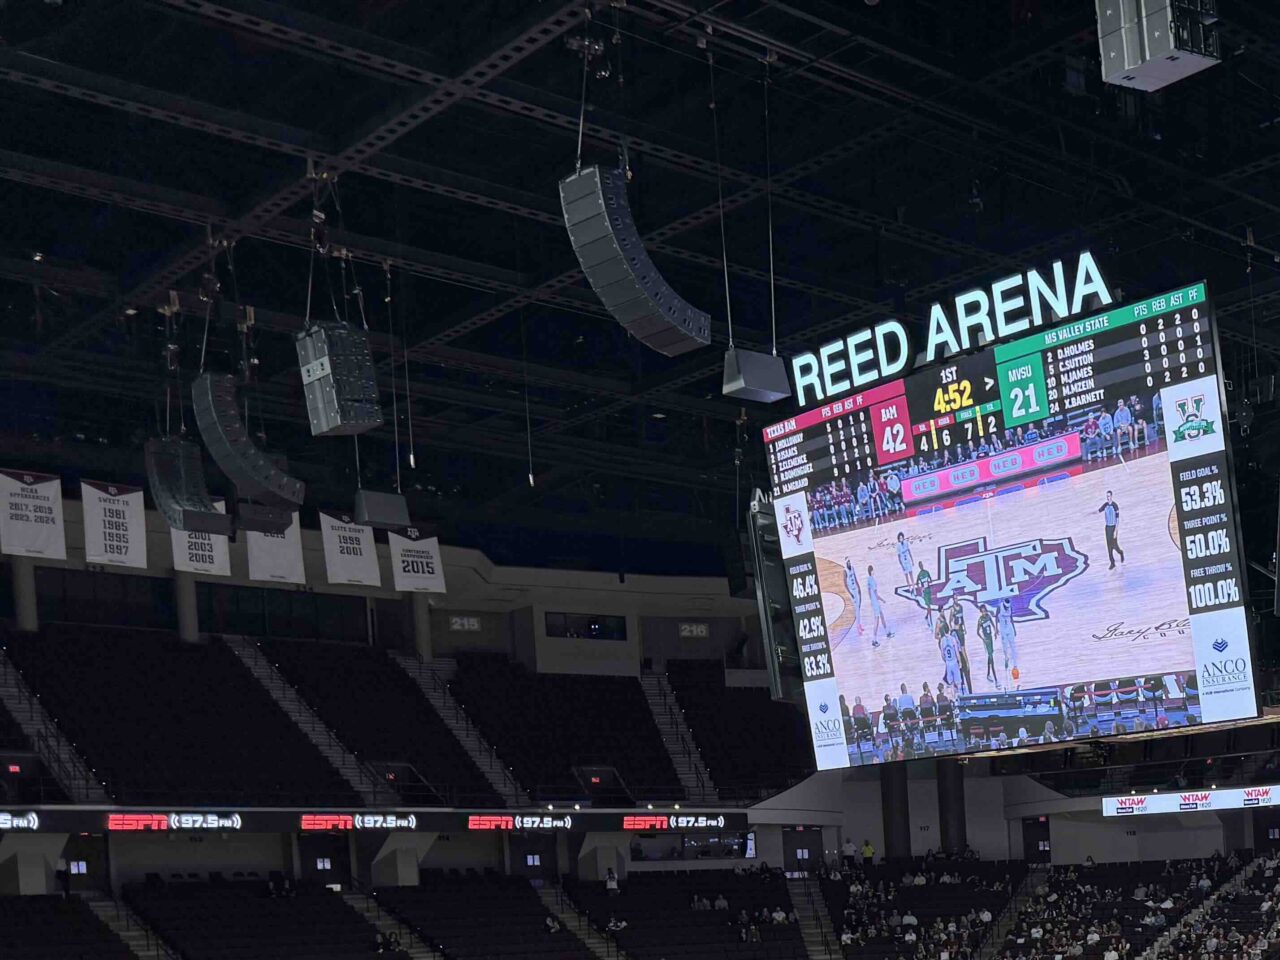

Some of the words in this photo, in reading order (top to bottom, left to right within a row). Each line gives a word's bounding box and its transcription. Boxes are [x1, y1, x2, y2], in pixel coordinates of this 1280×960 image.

[1045, 333, 1057, 346] MS
[1058, 324, 1084, 341] VALLEY
[1085, 316, 1110, 332] STATE
[1134, 305, 1148, 318] PTS
[1152, 299, 1166, 313] REB
[1170, 293, 1183, 307] AST
[1188, 288, 1198, 301] PF
[791, 318, 909, 407] REED
[925, 249, 1113, 362] ARENA
[1047, 352, 1053, 363] 2
[1057, 340, 1095, 360] D.HOLMES
[1140, 324, 1147, 335] 0
[1157, 319, 1164, 330] 2
[1174, 313, 1181, 325] 2
[1191, 308, 1198, 319] 0
[1048, 364, 1055, 375] 5
[1059, 353, 1094, 372] C.SUTTON
[1141, 337, 1148, 348] 0
[1159, 332, 1166, 343] 0
[1176, 327, 1183, 338] 0
[1193, 322, 1200, 333] 0
[1046, 377, 1056, 389] 10
[1060, 366, 1093, 385] M.JAMES
[1143, 349, 1150, 361] 3
[1160, 344, 1167, 355] 0
[1177, 340, 1184, 351] 0
[1195, 335, 1202, 346] 1
[940, 366, 958, 384] 1ST
[1008, 365, 1032, 383] MVSU
[1048, 389, 1058, 401] 20
[1062, 378, 1095, 396] M.MZEIN
[1145, 362, 1151, 373] 0
[1162, 357, 1169, 368] 0
[1179, 352, 1186, 363] 0
[1196, 348, 1203, 359] 0
[1049, 402, 1060, 414] 24
[1064, 388, 1105, 409] X.BARNETT
[1146, 376, 1153, 387] 0
[1164, 371, 1171, 382] 2
[1181, 366, 1188, 378] 2
[1198, 361, 1205, 373] 0
[933, 379, 974, 414] 4:52
[1009, 383, 1040, 418] 21
[964, 422, 973, 440] 7
[987, 415, 997, 433] 2
[882, 423, 907, 454] 42
[920, 435, 928, 452] 4
[942, 429, 951, 446] 6
[1179, 469, 1197, 482] FIELD
[1197, 467, 1213, 479] GOAL
[1180, 480, 1225, 512] 53.3%
[103, 507, 127, 520] 1981
[1183, 517, 1201, 530] THREE
[1202, 515, 1220, 528] POINT
[102, 531, 129, 544] 1995
[1185, 528, 1230, 560] 50.0%
[103, 543, 129, 556] 1997
[187, 540, 214, 553] 2003
[338, 544, 363, 557] 2001
[187, 551, 215, 564] 2009
[401, 559, 436, 576] 2015
[1190, 568, 1204, 579] FREE
[1204, 565, 1225, 577] THROW
[792, 574, 818, 599] 46.4%
[1188, 577, 1240, 609] 100.0%
[451, 617, 479, 630] 215
[680, 624, 706, 637] 216
[798, 615, 825, 640] 42.9%
[804, 653, 831, 677] 83.3%
[1202, 657, 1247, 678] ANCO
[1202, 674, 1248, 686] INSURANCE
[815, 718, 841, 735] ANCO
[13, 817, 28, 828] FM
[108, 814, 169, 830] ESPN
[181, 813, 219, 829] 97.5
[219, 818, 233, 827] FM
[301, 814, 353, 830] ESPN
[364, 815, 397, 828] 97.5
[397, 819, 409, 827] FM
[468, 815, 514, 830] ESPN
[523, 816, 553, 828] 97.5
[623, 815, 669, 829] ESPN
[678, 816, 708, 828] 97.5
